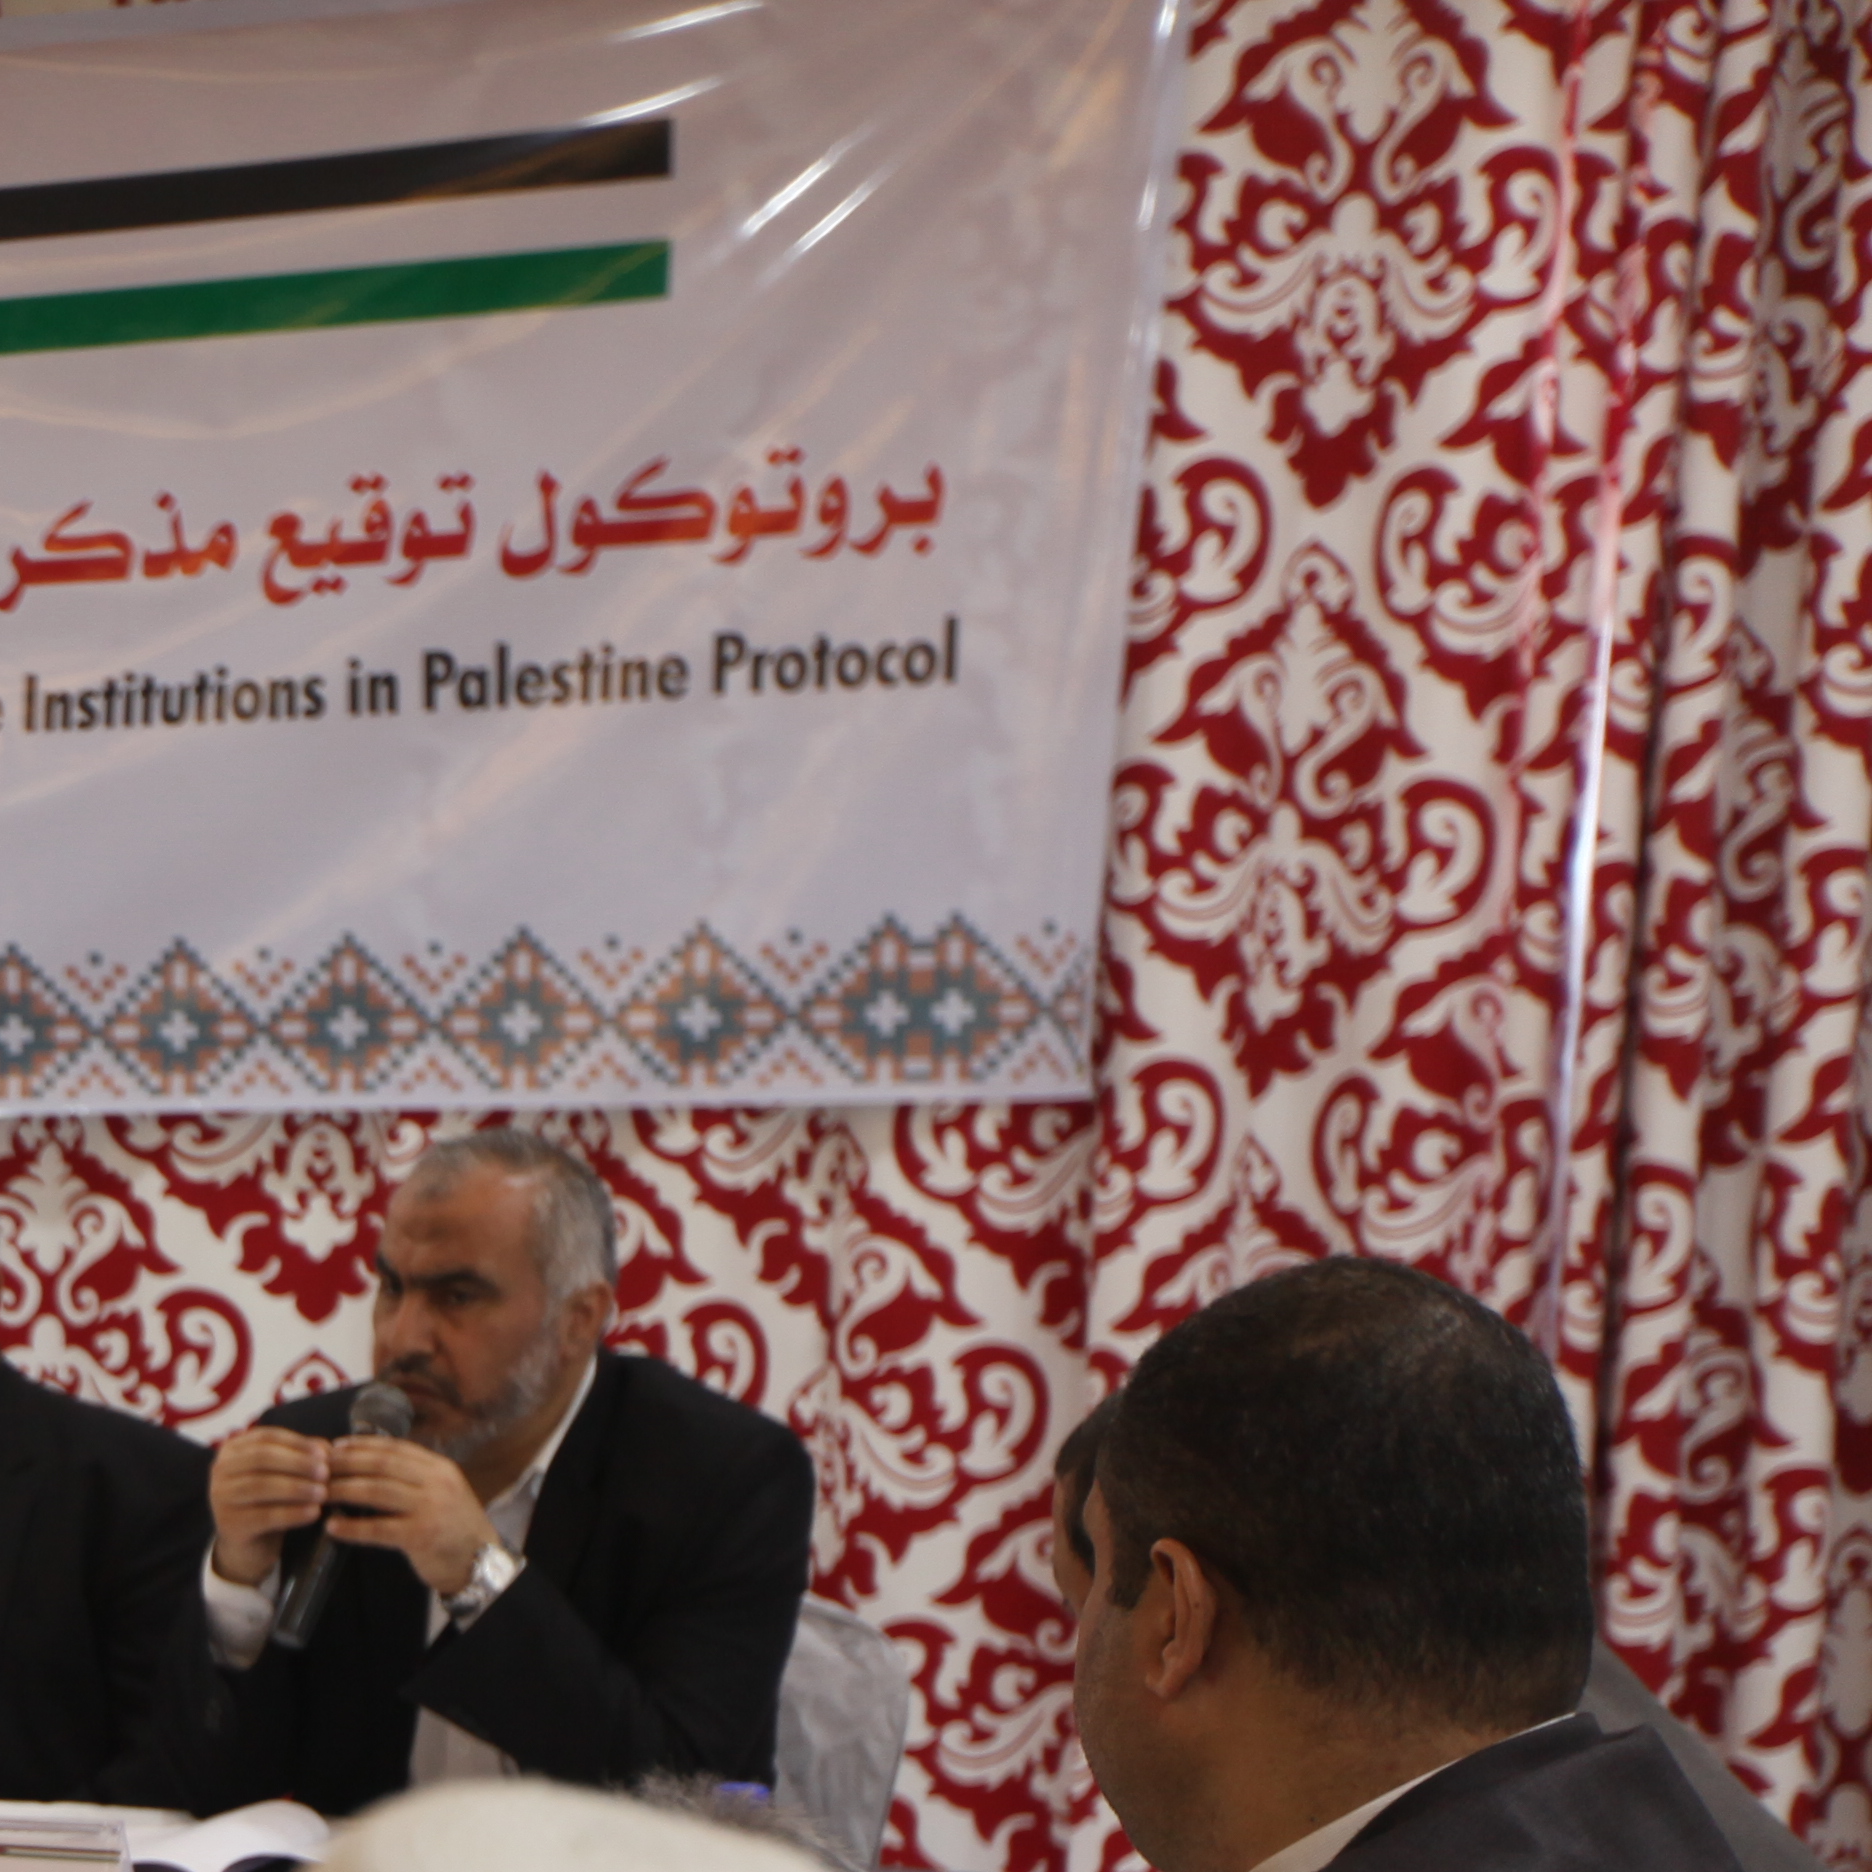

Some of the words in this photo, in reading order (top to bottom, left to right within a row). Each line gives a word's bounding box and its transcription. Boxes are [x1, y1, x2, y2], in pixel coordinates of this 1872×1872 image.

[260, 475, 475, 606] توقيع
[500, 448, 946, 578] بروتوكول
[24, 665, 328, 732] Institutions
[347, 658, 400, 716] in
[422, 640, 691, 713] Palestine
[711, 616, 960, 694] Protocol
